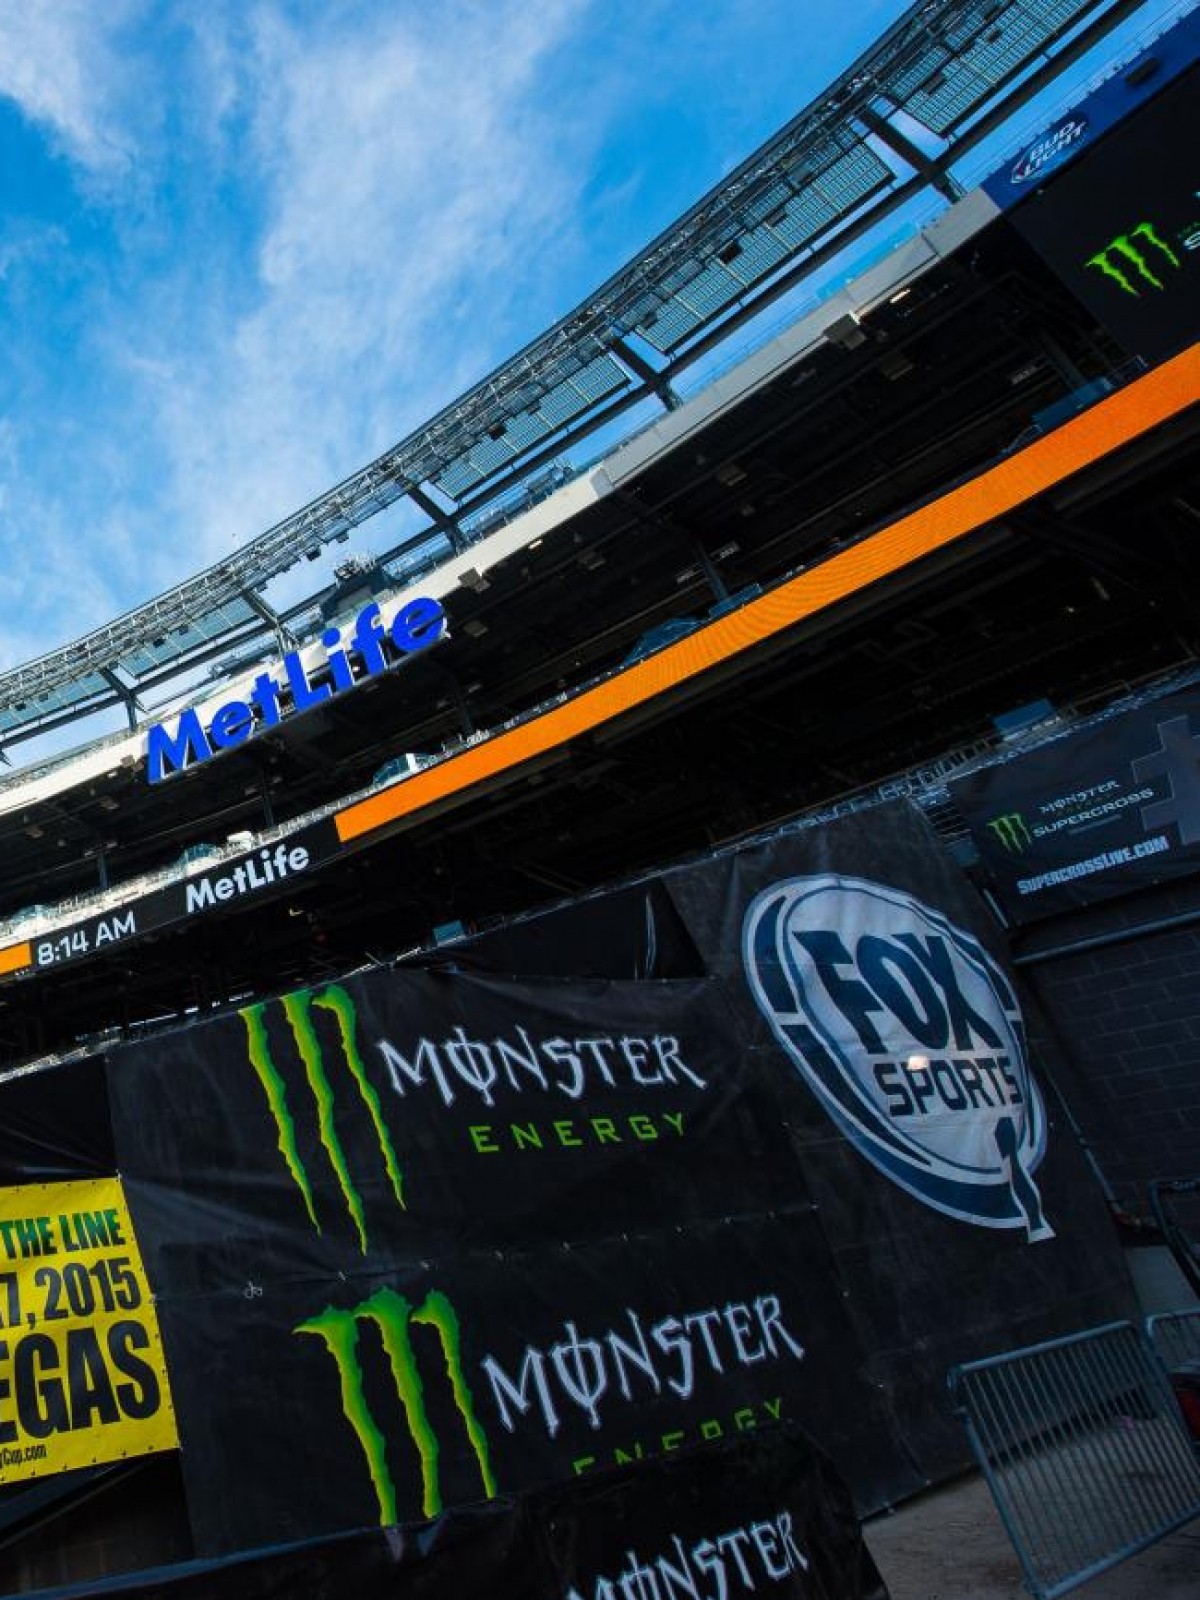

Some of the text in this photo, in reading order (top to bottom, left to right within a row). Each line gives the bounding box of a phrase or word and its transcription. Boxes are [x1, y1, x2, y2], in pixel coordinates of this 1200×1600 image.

[1024, 121, 1087, 177] LIGHT
[1029, 121, 1075, 162] BUD
[147, 597, 448, 785] MetLife
[1032, 787, 1155, 838] SUPERCROSS
[185, 842, 310, 914] MetLife
[37, 909, 138, 967] 8:14 AM
[793, 929, 1005, 1056] FOX
[376, 1024, 706, 1108] MONSTER
[873, 1054, 1025, 1118] SPORTS
[468, 1111, 686, 1153] ENERGY
[61, 1208, 126, 1253] LINE
[480, 1293, 805, 1439] MONSTER
